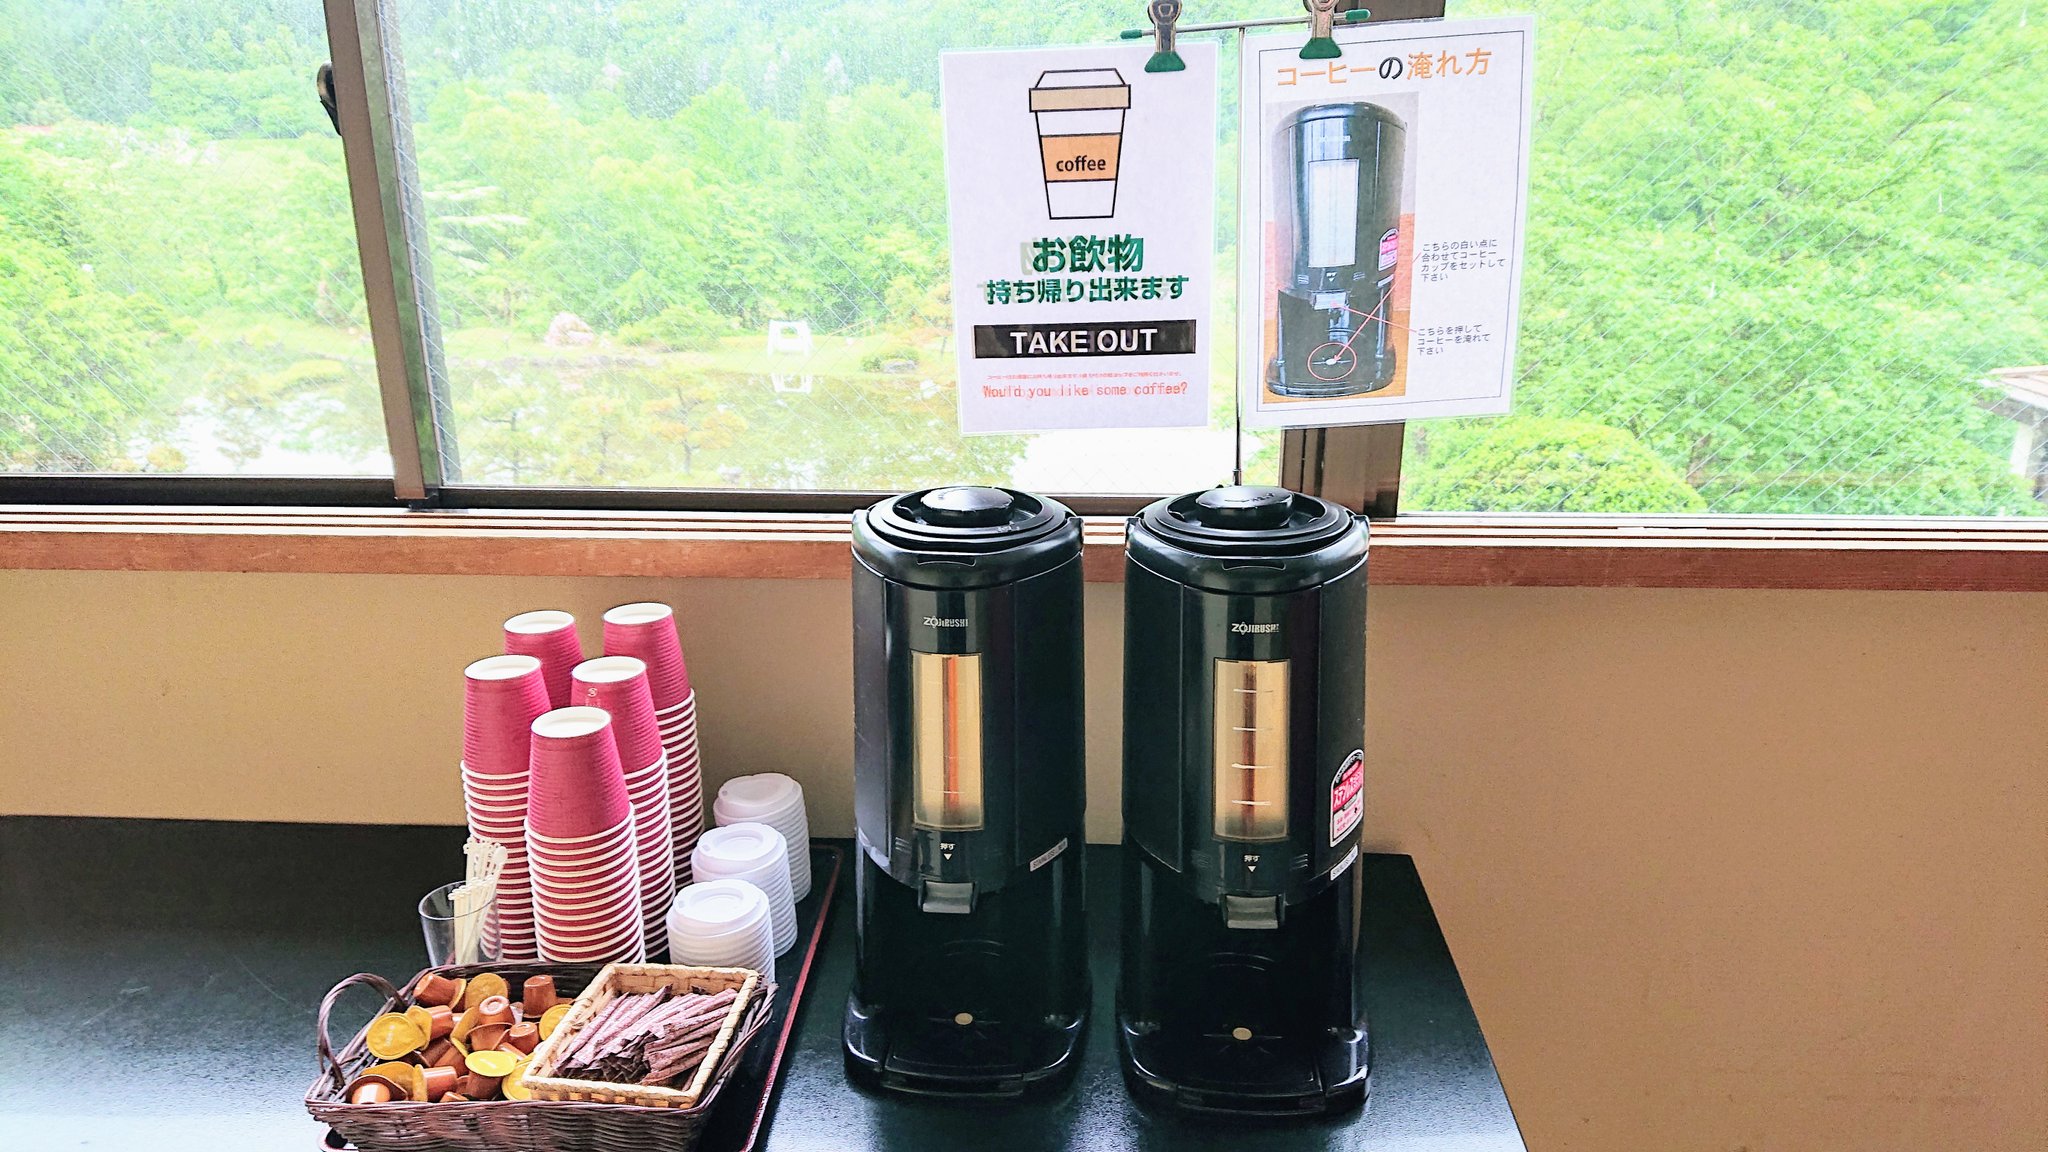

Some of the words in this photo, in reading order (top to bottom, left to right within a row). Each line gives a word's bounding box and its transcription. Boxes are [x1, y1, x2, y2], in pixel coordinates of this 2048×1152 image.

[1277, 47, 1492, 86] コーヒーの淹れ方
[1056, 155, 1106, 172] coffee
[1423, 239, 1498, 252] こちらの白い点に
[1032, 234, 1144, 273] お飲物
[1421, 250, 1497, 263] 合わせてコーヒー
[1421, 259, 1506, 273] カップをセットして
[1421, 273, 1448, 283] 下さい
[987, 275, 1189, 305] 持ち帰り出来ます
[1418, 324, 1482, 336] こちらを押して
[1010, 330, 1088, 355] TAKE
[1096, 328, 1158, 353] OUT
[1417, 347, 1443, 356] 下さい
[983, 385, 1021, 398] Would
[1029, 387, 1051, 399] you
[1061, 384, 1089, 397] like
[1096, 386, 1127, 396] some
[1134, 381, 1188, 395] coffee?
[923, 615, 969, 629] ZOJIRUSHI
[1231, 621, 1280, 636] ZOJIRUSHI
